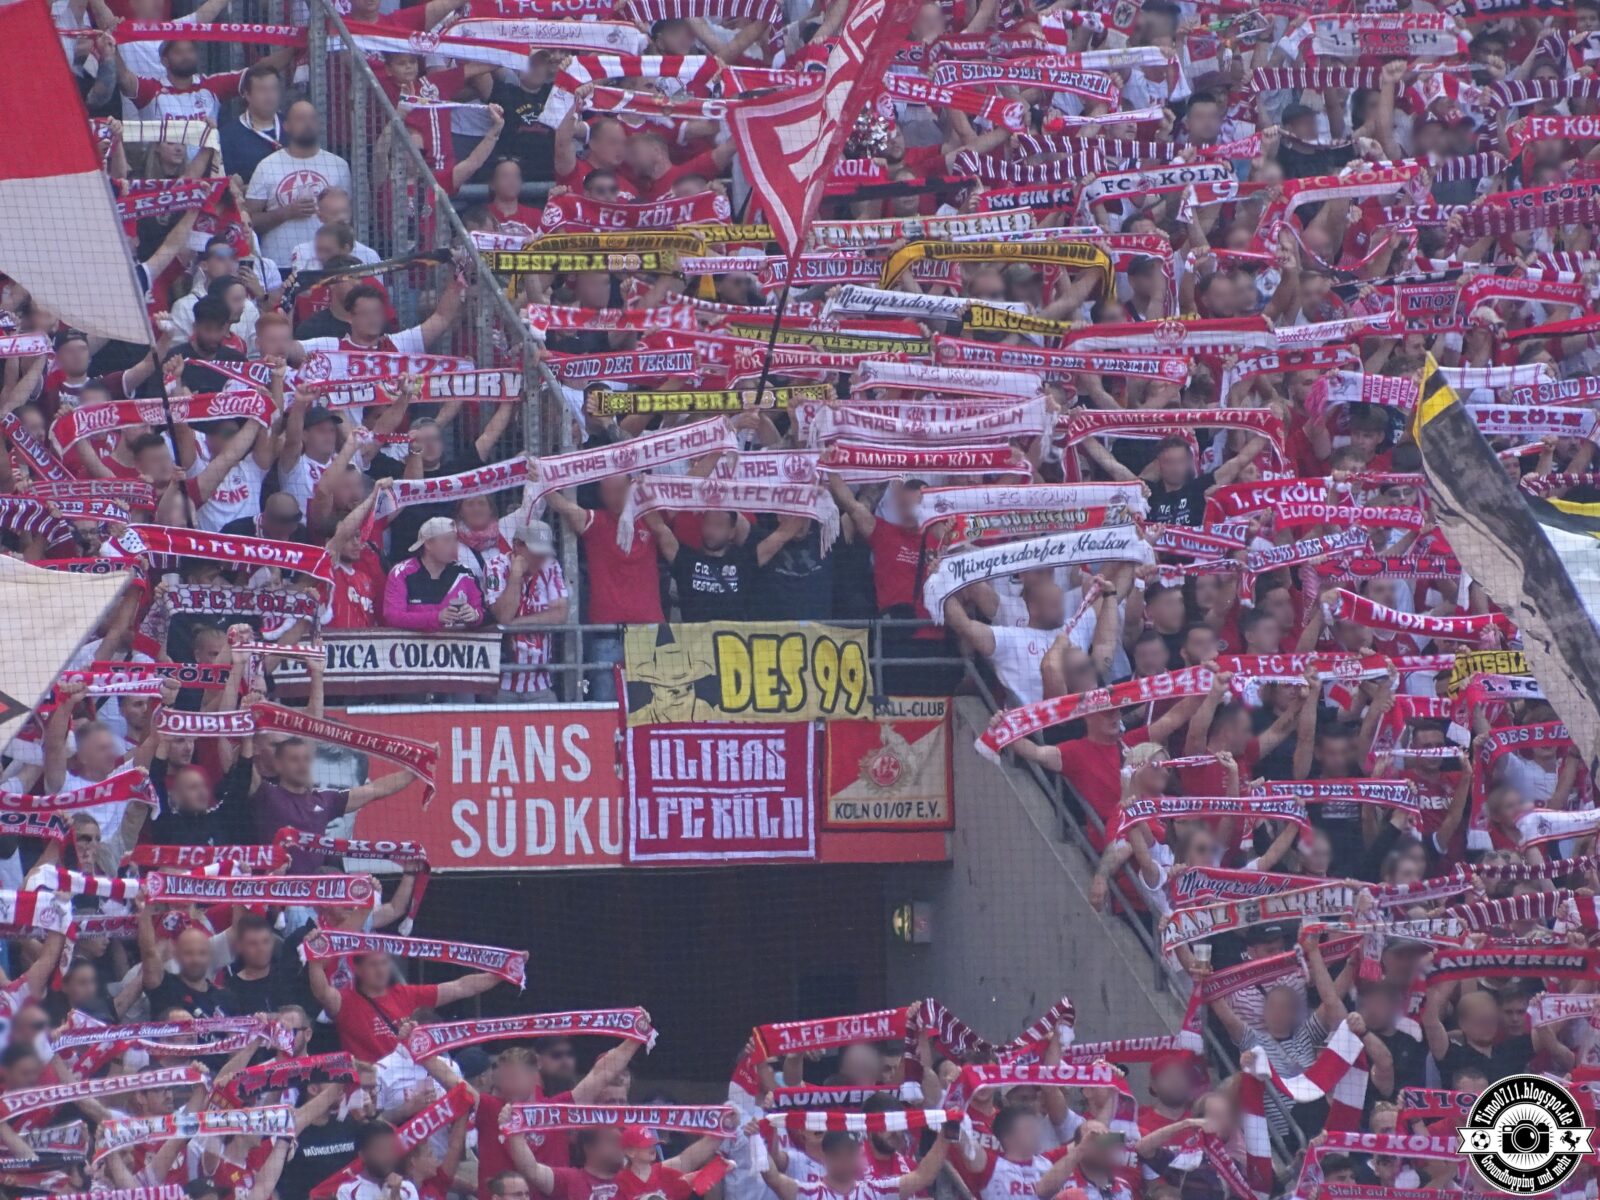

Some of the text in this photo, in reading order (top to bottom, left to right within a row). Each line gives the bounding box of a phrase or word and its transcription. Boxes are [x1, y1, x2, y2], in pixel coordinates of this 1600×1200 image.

[132, 22, 301, 37] MADE IN COLOGNE
[962, 63, 1111, 96] SIND DER VEREIN
[1103, 166, 1228, 193] FC KÖLN
[1020, 194, 1048, 208] BIN
[575, 202, 694, 227] 1. FC KÖLN
[924, 244, 1098, 260] BORUSSIA DORTMUND
[807, 259, 883, 277] SIND DER
[565, 351, 694, 379] SIND DER VEREIN
[1049, 354, 1085, 368] DER
[1092, 359, 1160, 373] VEREIN
[1539, 379, 1579, 401] SIND
[74, 393, 266, 433] Laut Stark
[1476, 408, 1583, 427] FC KÖLN
[542, 455, 607, 483] ULTRAS
[680, 424, 726, 449] KÖLN
[855, 450, 907, 466] IMMER
[948, 449, 994, 467] KÖLN
[424, 476, 452, 492] FC
[998, 492, 1022, 504] FC
[1231, 491, 1249, 509] 1.
[1253, 486, 1276, 503] FC
[189, 537, 304, 565] 1. FC KÖLN
[948, 542, 1066, 581] Müngersdorfer
[1070, 536, 1130, 561] Stadion
[1432, 618, 1454, 632] FC
[389, 642, 490, 669] COLONIA
[1232, 657, 1251, 675] 1.
[1258, 655, 1284, 673] FC
[713, 631, 867, 714] DES 99
[1483, 679, 1504, 692] 1.
[995, 669, 1213, 743] SEIT 1948
[1429, 698, 1452, 718] FC
[307, 719, 352, 742] IMMER
[1496, 728, 1530, 746] BES
[1534, 726, 1545, 740] E
[451, 724, 591, 784] HANS
[650, 738, 786, 782] ULTRAS
[712, 794, 803, 839] KÖLN
[834, 801, 941, 819] KÖLN 01/07 E.V.
[1127, 799, 1157, 818] WIR
[298, 833, 336, 849] FC
[178, 846, 206, 865] FC
[165, 876, 346, 899] WIR SIND DER VEREIN
[331, 934, 509, 969] WIR SIND DER VEREIN
[428, 1012, 636, 1046] WIR SIND DIE FANS
[780, 1018, 891, 1043] 1. FC KÖLN
[974, 1066, 1033, 1081] 1. FC
[6, 1066, 188, 1112] DOUBLESIEGER
[524, 1107, 722, 1128] WIR SIND DIE FANS
[1344, 1131, 1377, 1147] FC
